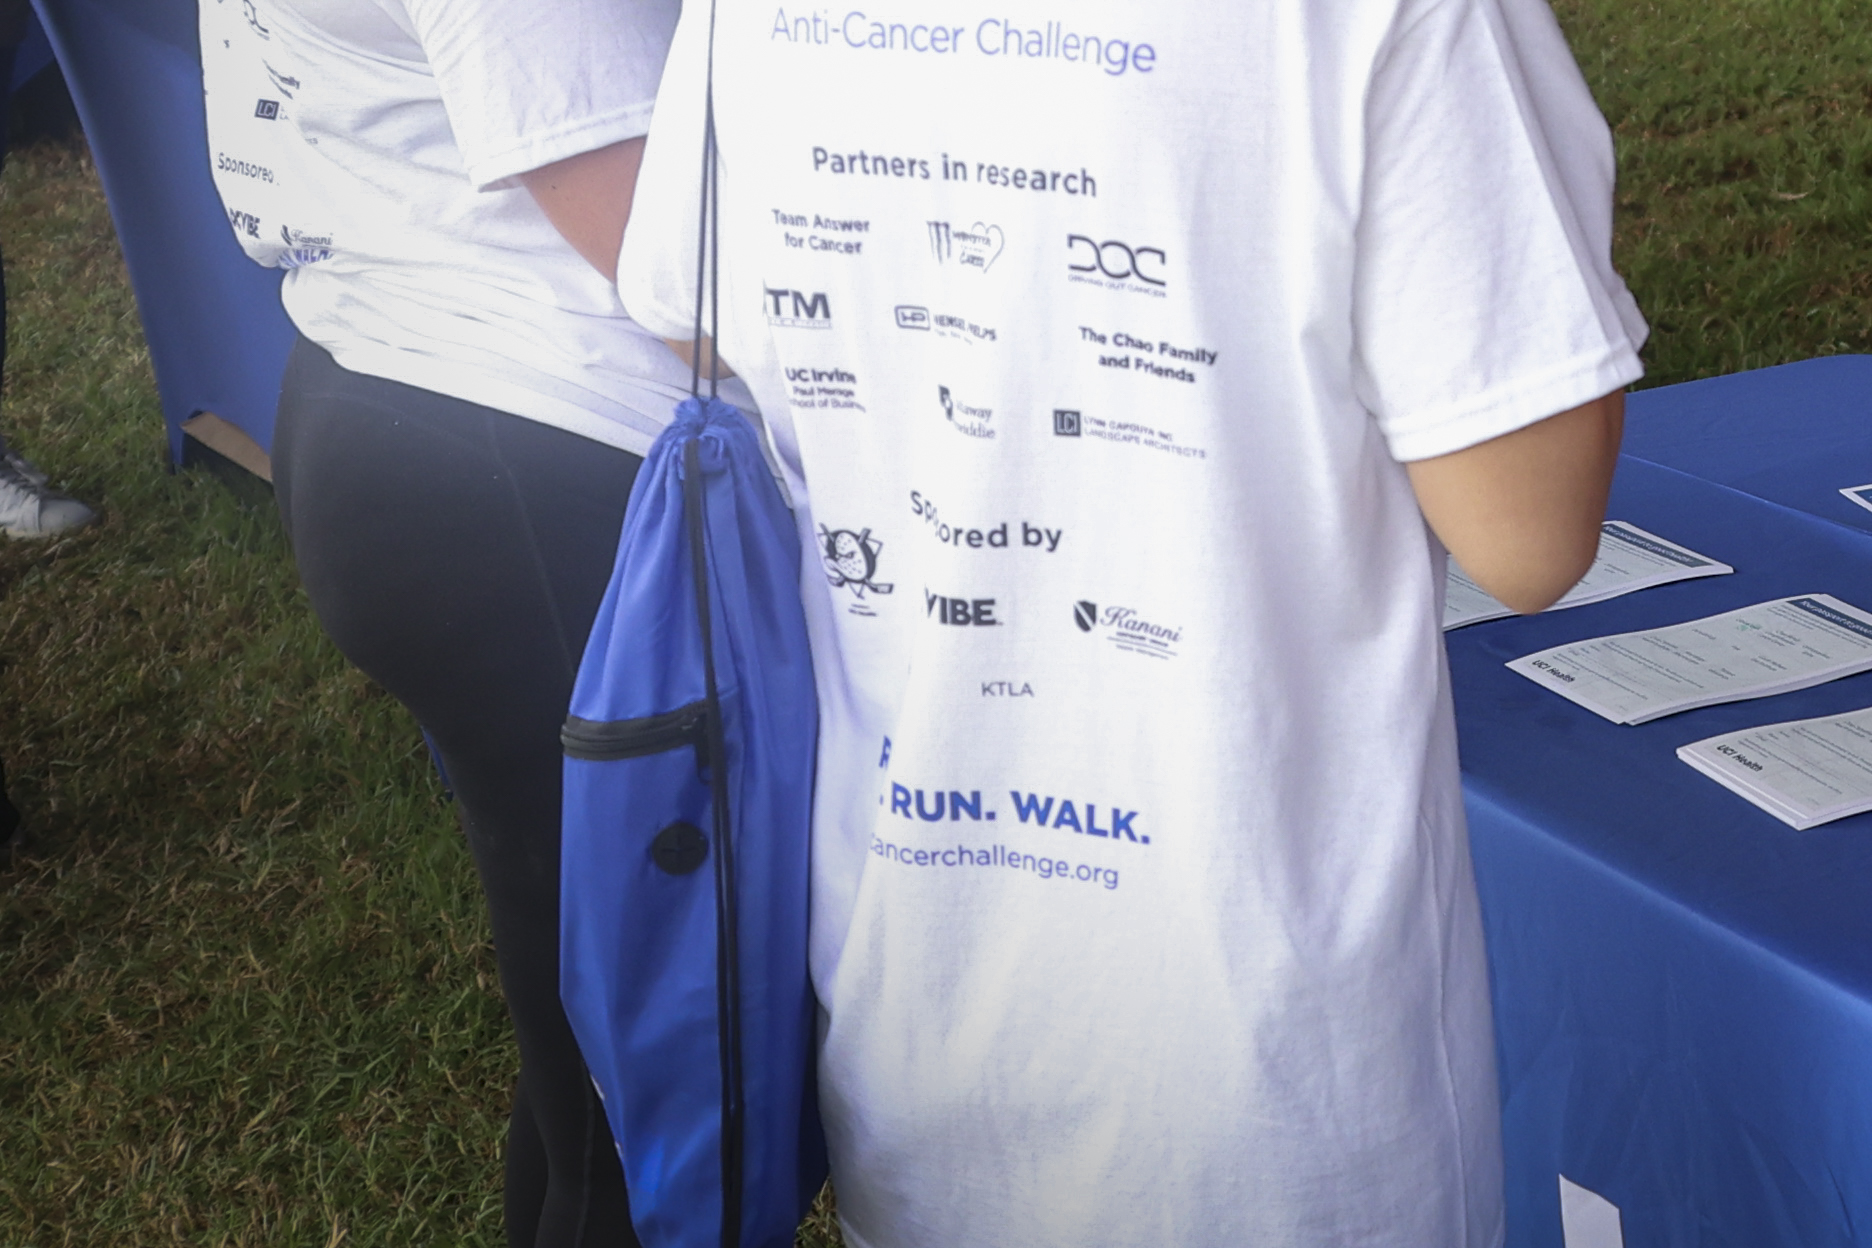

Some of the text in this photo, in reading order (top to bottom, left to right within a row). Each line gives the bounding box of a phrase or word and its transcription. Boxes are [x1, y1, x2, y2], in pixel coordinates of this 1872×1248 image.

[771, 7, 1157, 76] Anti-Cancer Challenge
[811, 146, 1098, 197] Partners in research
[771, 209, 871, 233] Team Answer
[784, 231, 863, 255] for Cancer
[1078, 325, 1218, 367] The Chao Family
[785, 367, 811, 382] UC
[1098, 354, 1196, 384] and Friends
[1055, 411, 1079, 435] LCI
[1084, 415, 1107, 428] LYNN
[1084, 427, 1207, 459] LANDSCAPE ARCHITECTS
[1021, 522, 1062, 553] by
[1100, 605, 1183, 644] Kanani
[980, 681, 1035, 697] KTLA
[1716, 744, 1763, 772] UCI Health
[891, 781, 1151, 845] RUN. WALK.
